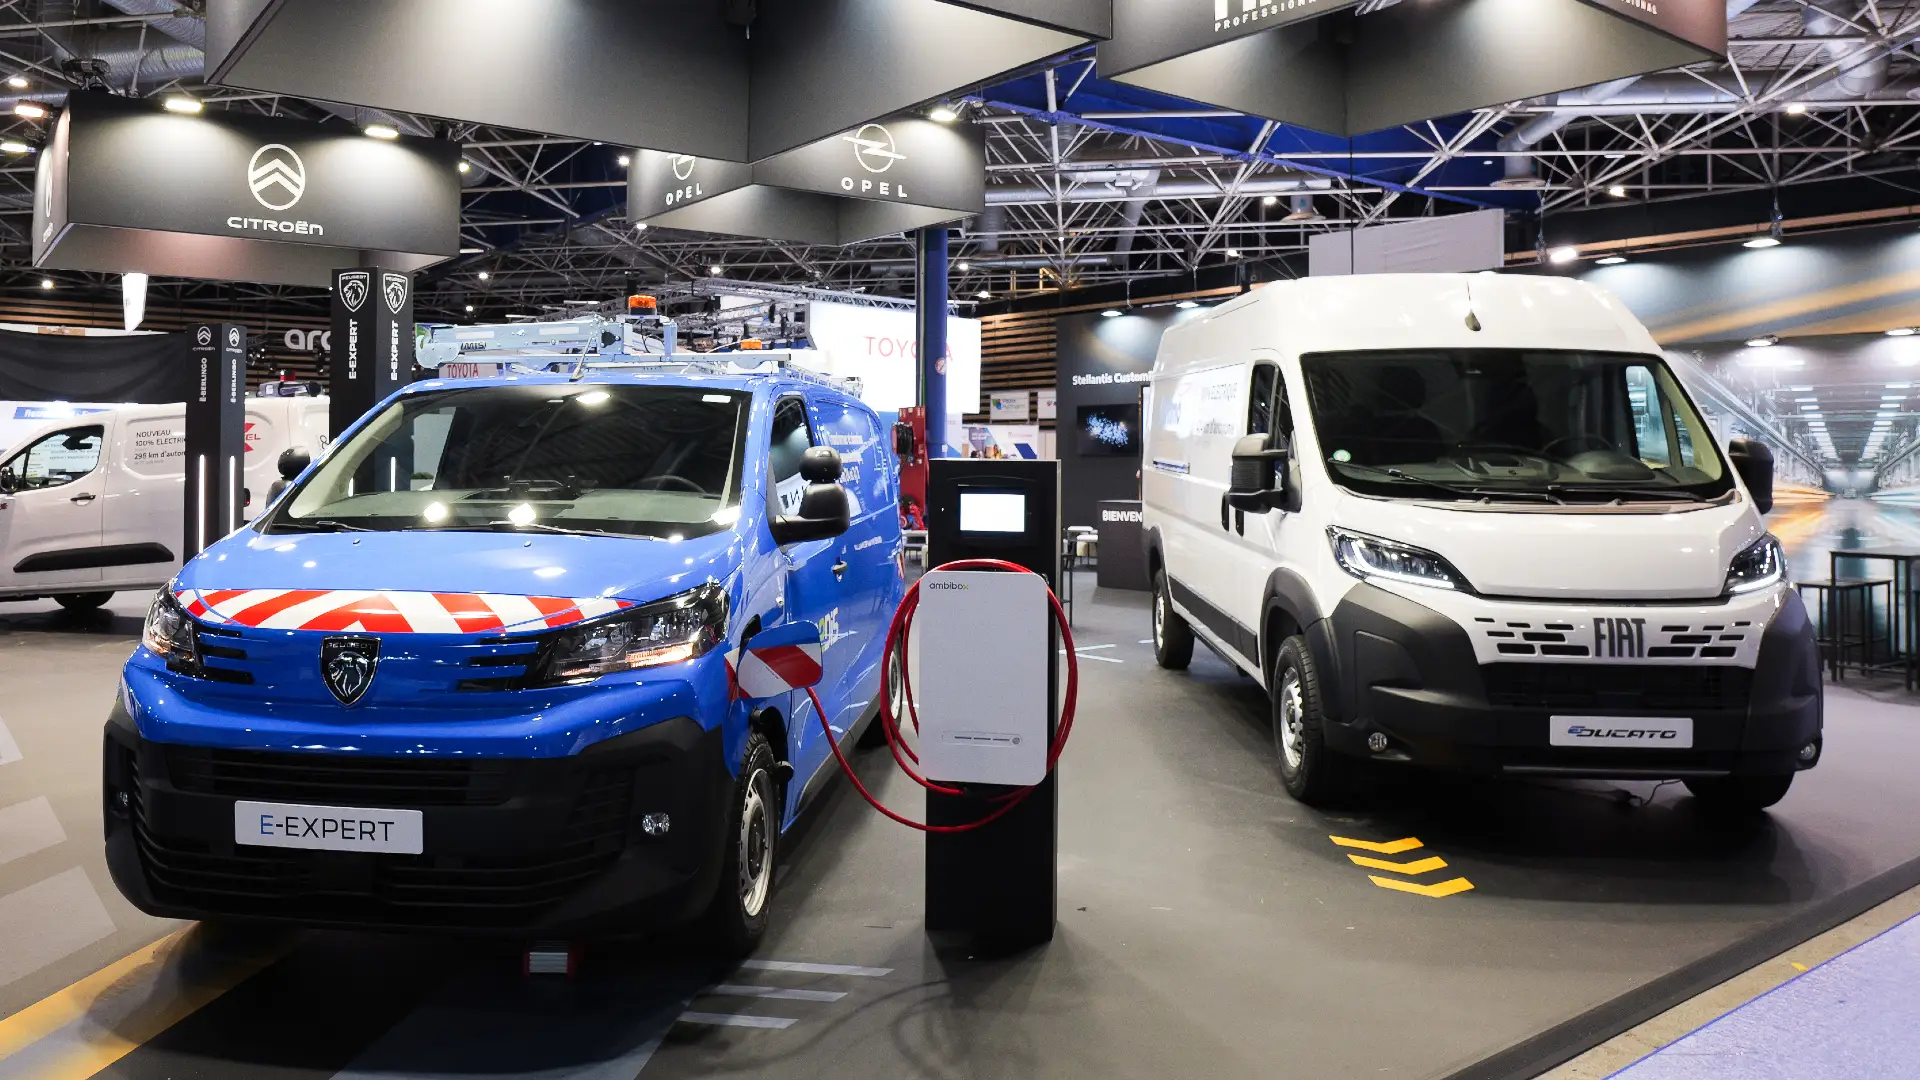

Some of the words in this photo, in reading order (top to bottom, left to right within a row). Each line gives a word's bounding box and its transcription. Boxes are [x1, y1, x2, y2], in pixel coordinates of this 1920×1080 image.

[1214, 0, 1316, 32] PROFESSION
[665, 183, 703, 206] OPEL
[841, 176, 908, 198] OPEL
[227, 215, 324, 236] CITROËN
[348, 318, 358, 379] E-EXPERT
[390, 320, 399, 381] E-EXPERT
[447, 363, 479, 378] TOYOTA
[1072, 373, 1113, 386] Stellantis
[136, 429, 171, 438] NOUVEAU
[148, 451, 159, 459] km
[1102, 509, 1143, 523] BIENVEN
[929, 581, 969, 590] ambibox
[325, 642, 374, 650] PEUGEOT
[1592, 617, 1647, 658] FIAT
[259, 813, 395, 843] E-EXPERT
